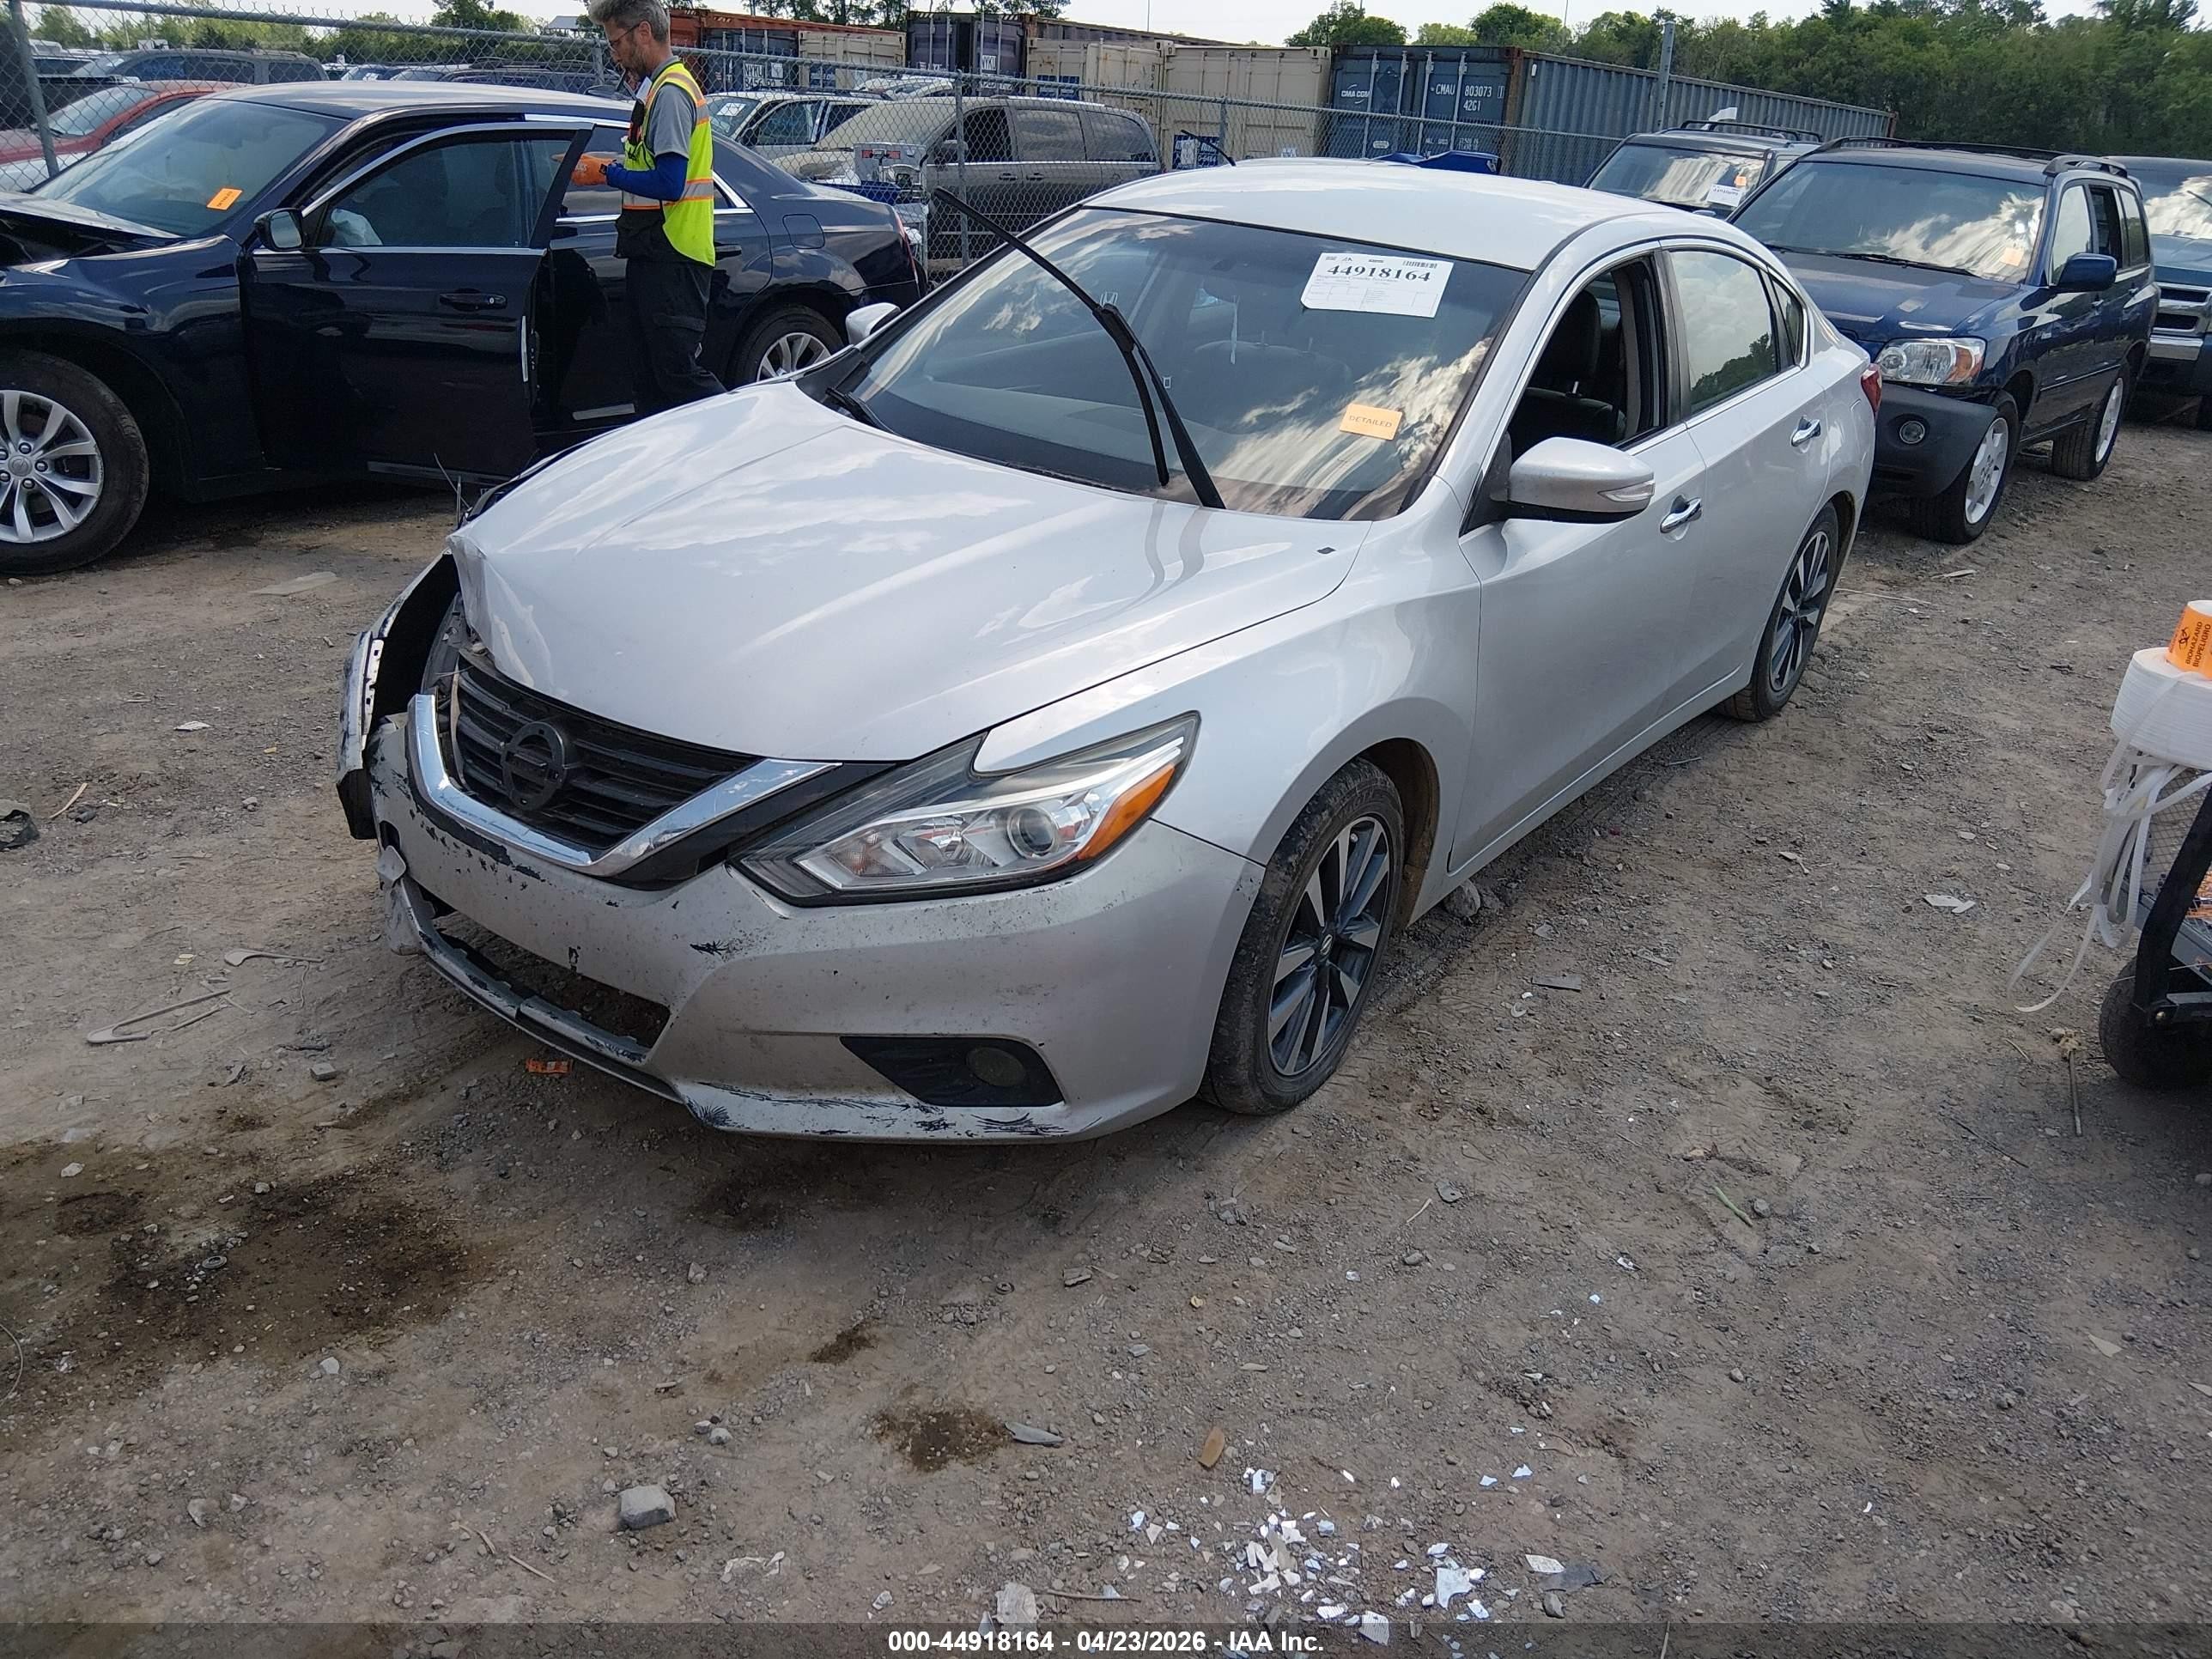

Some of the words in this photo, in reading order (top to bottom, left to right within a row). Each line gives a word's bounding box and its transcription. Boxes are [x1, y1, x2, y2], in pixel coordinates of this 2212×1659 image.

[744, 64, 763, 78] NYKU
[1436, 83, 1455, 95] CMAU
[1464, 85, 1492, 98] 803073
[1463, 100, 1481, 112] 42G1
[1327, 264, 1431, 283] 44918164
[1348, 415, 1393, 428] DETAILED
[2185, 621, 2203, 665] BIOHAZARD
[2192, 623, 2212, 667] BIOPELIGRO
